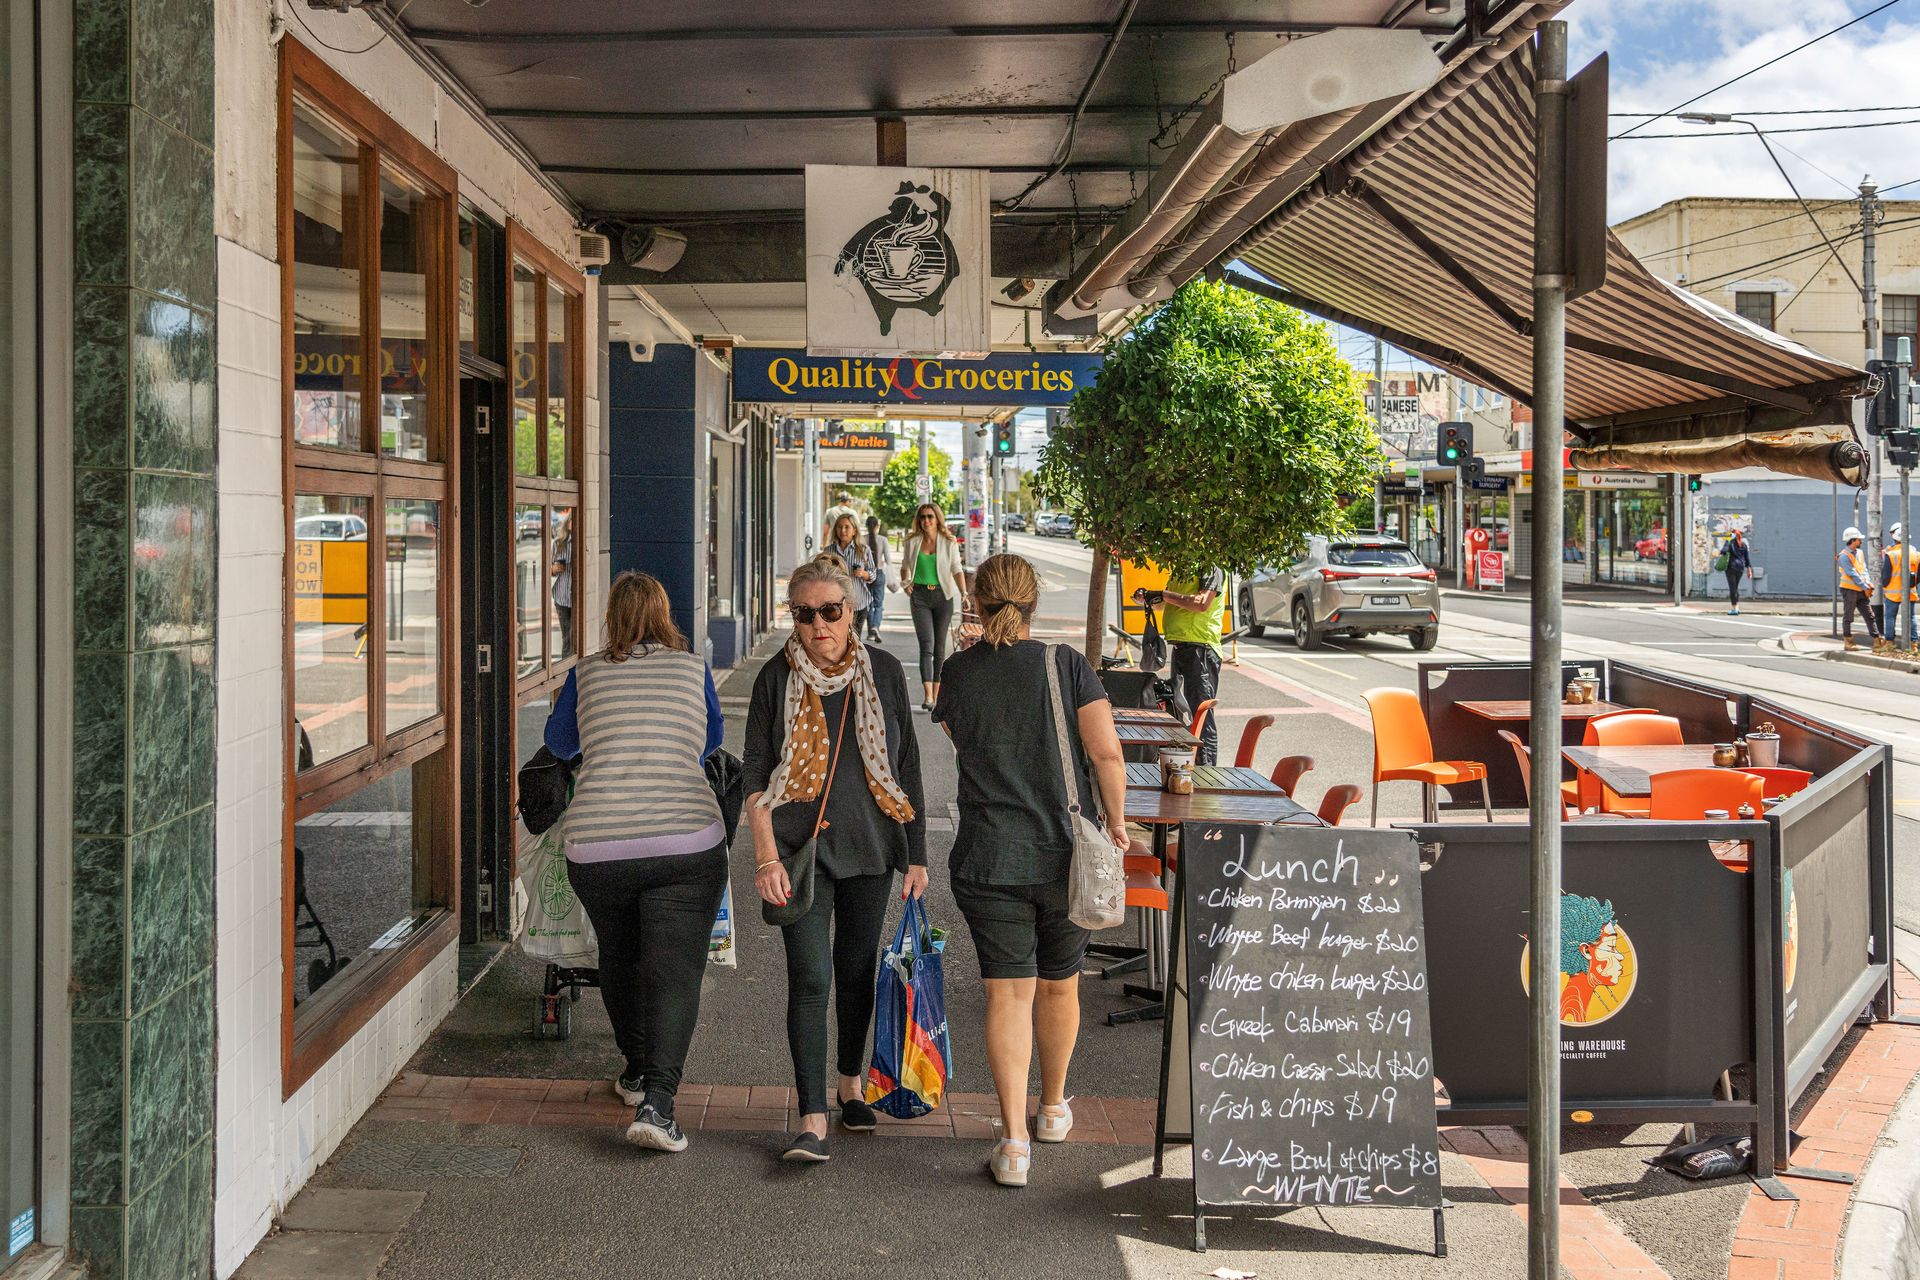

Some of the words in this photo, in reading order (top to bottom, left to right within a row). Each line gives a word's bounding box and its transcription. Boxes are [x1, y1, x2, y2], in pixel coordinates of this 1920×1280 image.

[767, 357, 898, 397] Quality
[914, 359, 1075, 392] Groceries
[1368, 400, 1418, 413] JPANESE
[1222, 834, 1359, 886] Lunch
[1357, 892, 1401, 914] $22
[1207, 922, 1264, 956] Whyte
[1270, 924, 1311, 950] Beef
[1318, 921, 1373, 958] burger
[1375, 929, 1420, 954] $20
[1208, 962, 1263, 998] Whyte
[1330, 964, 1381, 1000] burger
[1381, 965, 1426, 995] $20
[1211, 1006, 1275, 1043] Greek
[1284, 1006, 1359, 1034] Calamari
[1365, 1005, 1412, 1037] $19
[1560, 1041, 1575, 1051] ING
[1578, 1040, 1626, 1051] WAREHOUSE
[1560, 1052, 1585, 1060] PECIALTY
[1211, 1052, 1276, 1080] Chiken
[1281, 1053, 1334, 1081] Caesar
[1385, 1050, 1429, 1082] $20
[1208, 1090, 1254, 1124] Fish
[1260, 1099, 1273, 1117] &
[1343, 1086, 1398, 1124] $19
[1218, 1138, 1282, 1183] Large
[1402, 1143, 1438, 1177] $8
